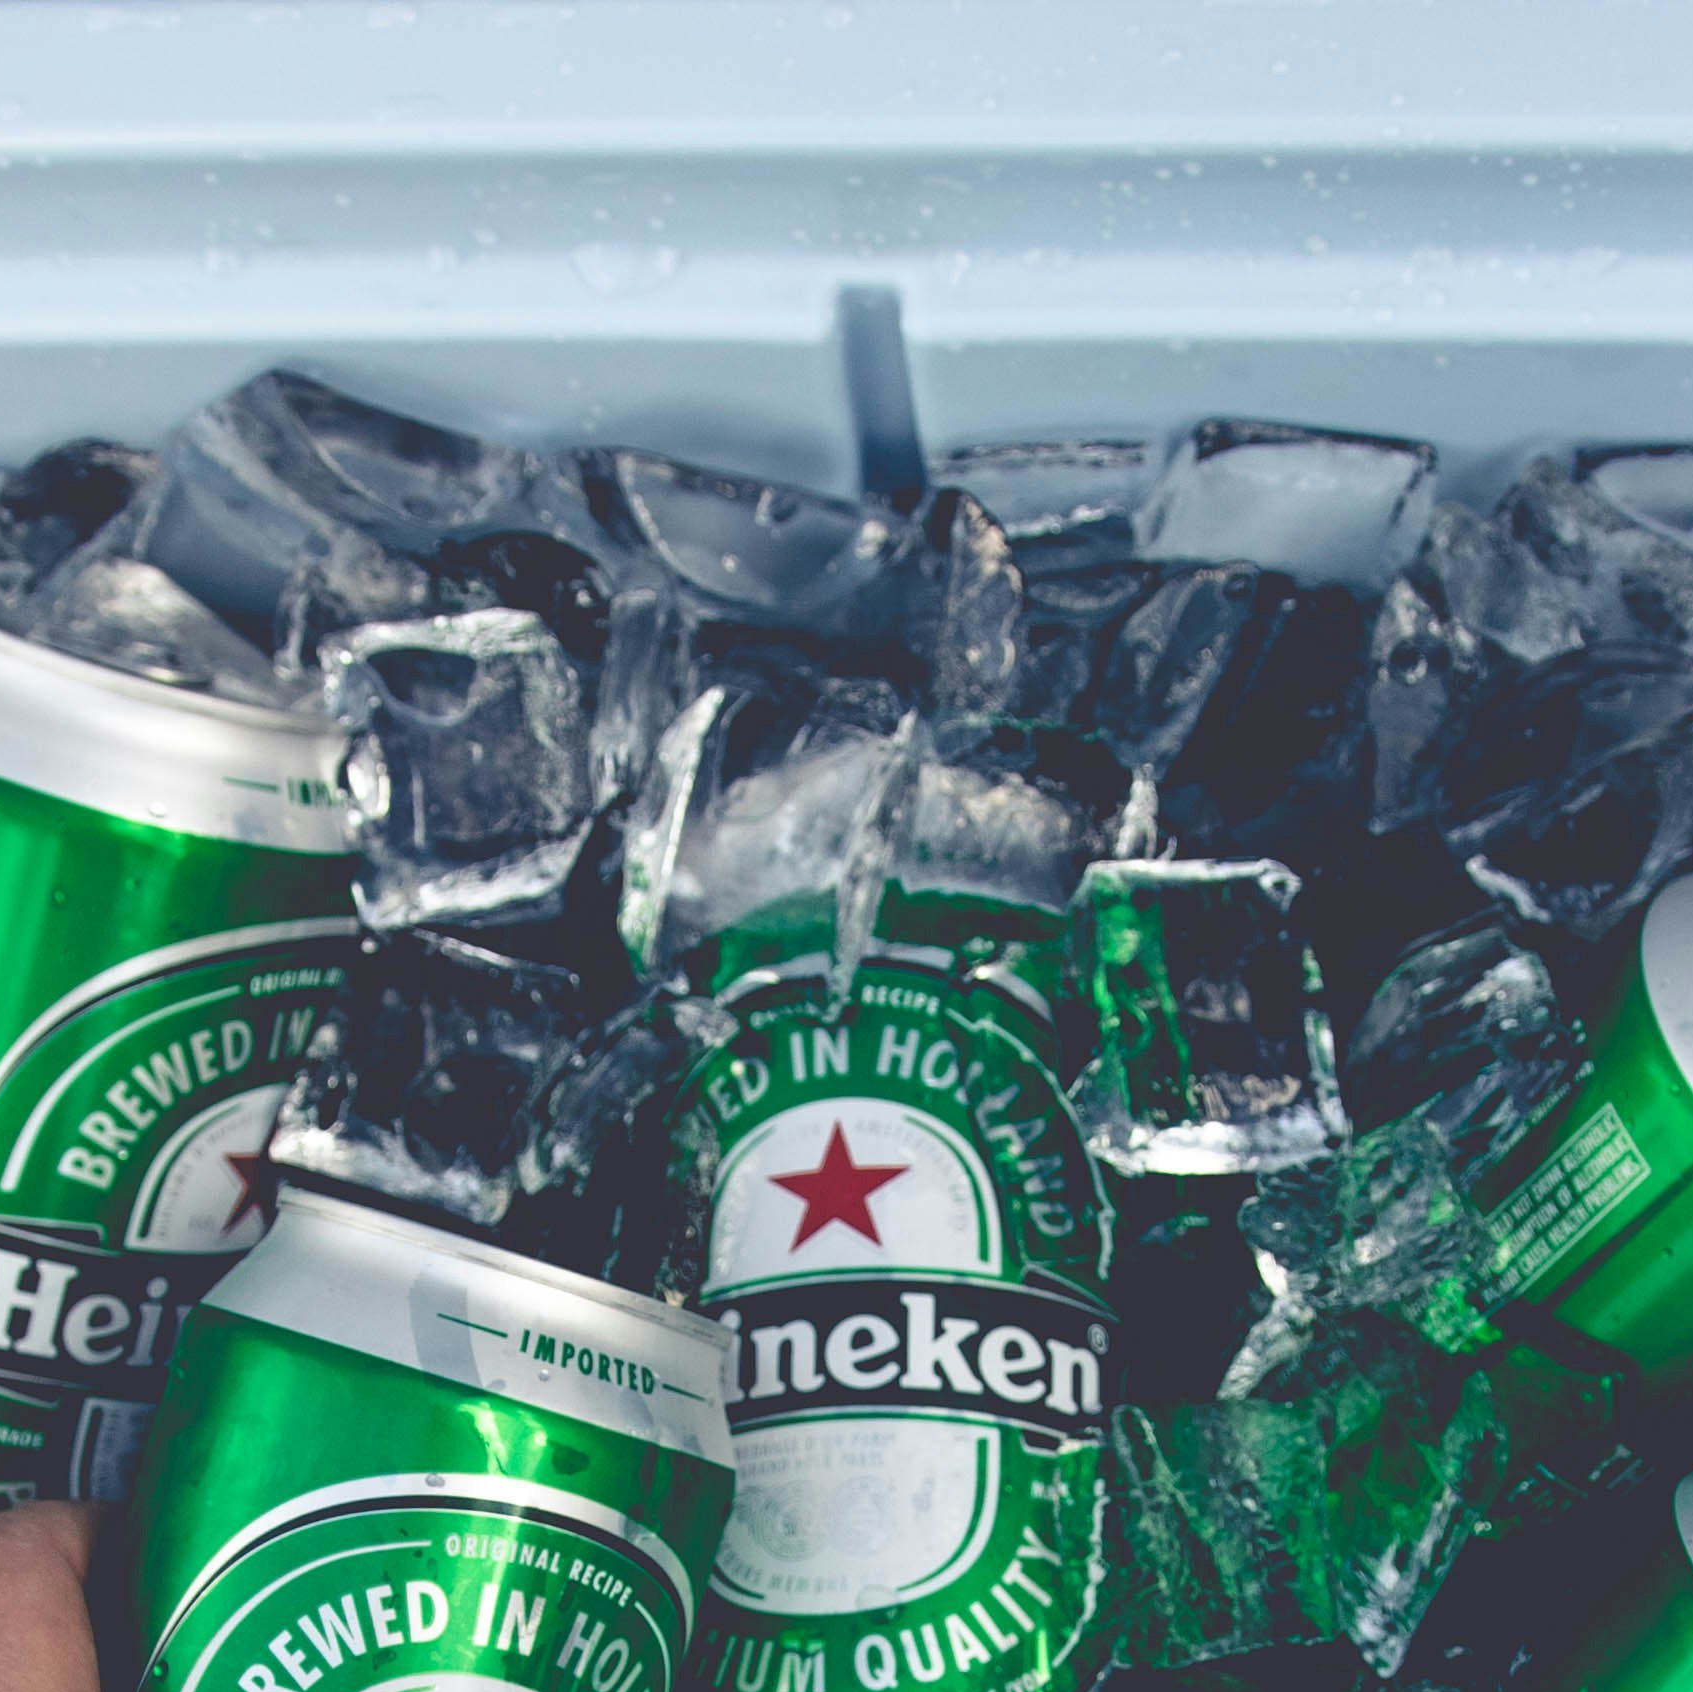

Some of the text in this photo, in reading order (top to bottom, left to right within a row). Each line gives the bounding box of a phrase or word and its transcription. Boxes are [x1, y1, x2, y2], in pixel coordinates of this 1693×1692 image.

[861, 983, 940, 1017] RECIPE
[57, 1019, 253, 1191] BREWED
[789, 1024, 1075, 1238] IN HOLLAND
[519, 1329, 656, 1394] IMPORTED
[445, 1533, 633, 1607] ORIGINAL RECIPE
[472, 1583, 547, 1658] IN
[854, 1525, 1063, 1691] QUALITY
